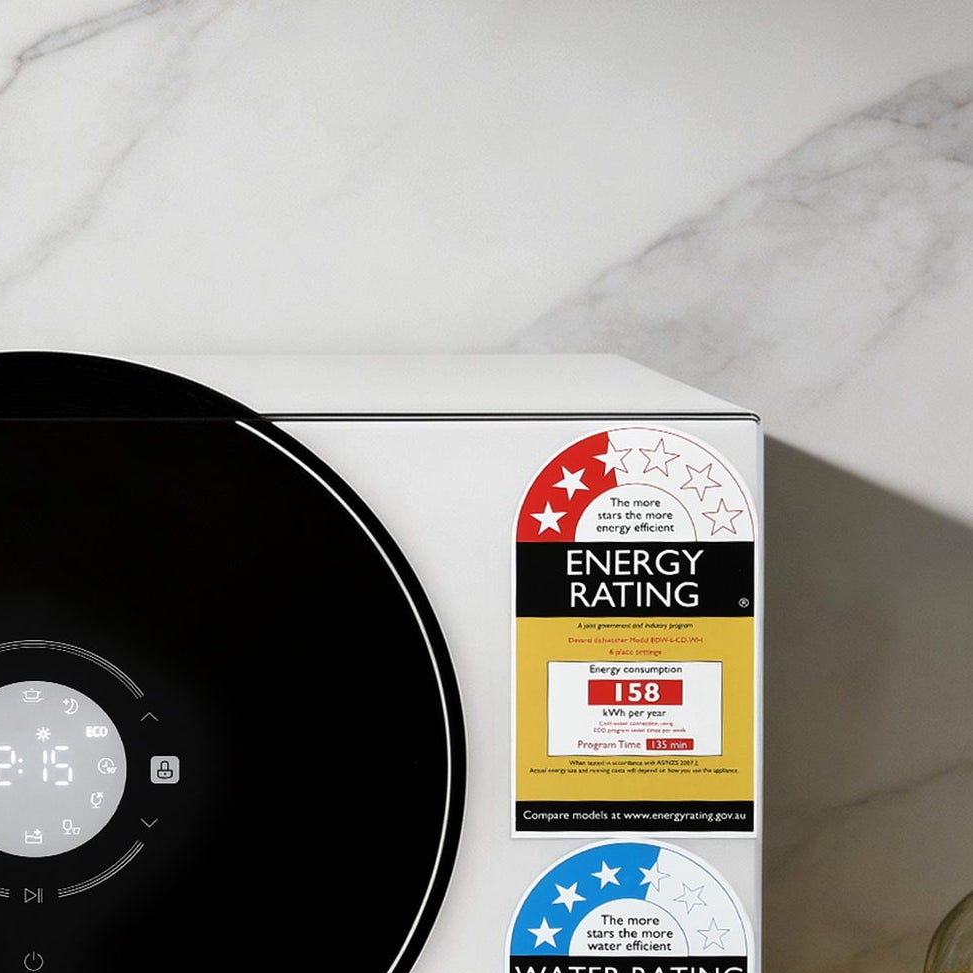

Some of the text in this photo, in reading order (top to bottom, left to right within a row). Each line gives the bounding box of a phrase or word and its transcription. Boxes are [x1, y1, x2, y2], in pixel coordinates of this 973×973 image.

[610, 498, 660, 507] The more
[598, 512, 673, 520] stars the more
[596, 523, 674, 534] energy efficient
[567, 550, 704, 575] ENERGY
[571, 582, 699, 607] RATING
[589, 665, 682, 675] Energy consumption
[614, 682, 660, 702] 158
[603, 709, 666, 719] kWh per year
[86, 726, 108, 738] ECO
[577, 740, 641, 750] Program Time
[650, 741, 687, 749] 135 min
[523, 810, 746, 822] Compare models at www.energyrating.gov.au
[601, 915, 659, 925] The more
[587, 928, 673, 938] stars the more
[587, 940, 672, 951] water efficient
